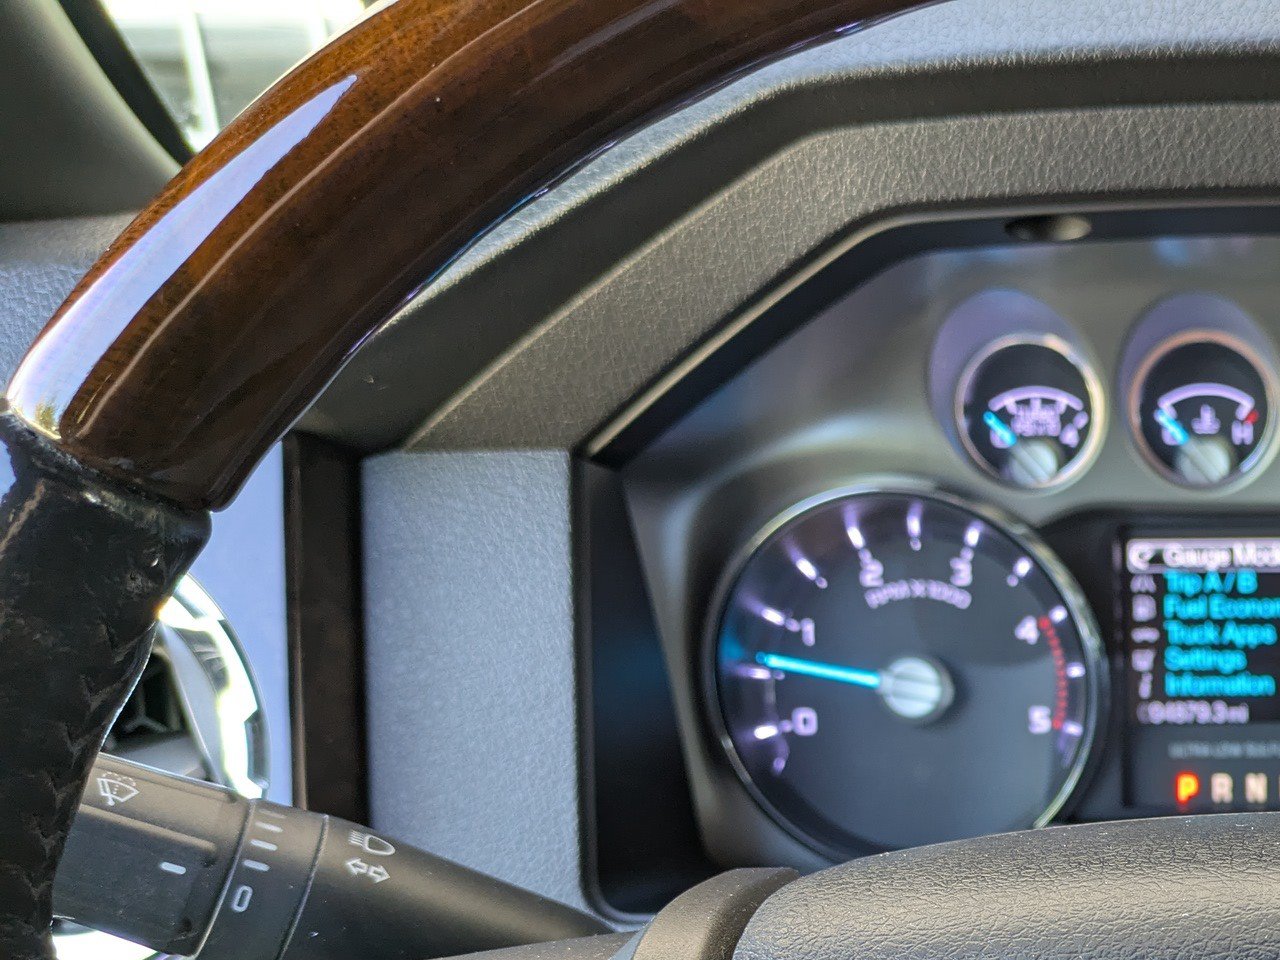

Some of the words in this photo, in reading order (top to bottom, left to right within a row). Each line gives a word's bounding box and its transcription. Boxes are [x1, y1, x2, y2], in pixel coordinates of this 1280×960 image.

[859, 559, 885, 587] 2
[950, 557, 973, 587] 3
[801, 617, 816, 647] 1
[1014, 615, 1040, 645] 4
[791, 706, 819, 736] 0
[1028, 705, 1053, 735] 5
[1175, 770, 1200, 804] P
[1210, 772, 1233, 803] R
[1244, 772, 1268, 803] N
